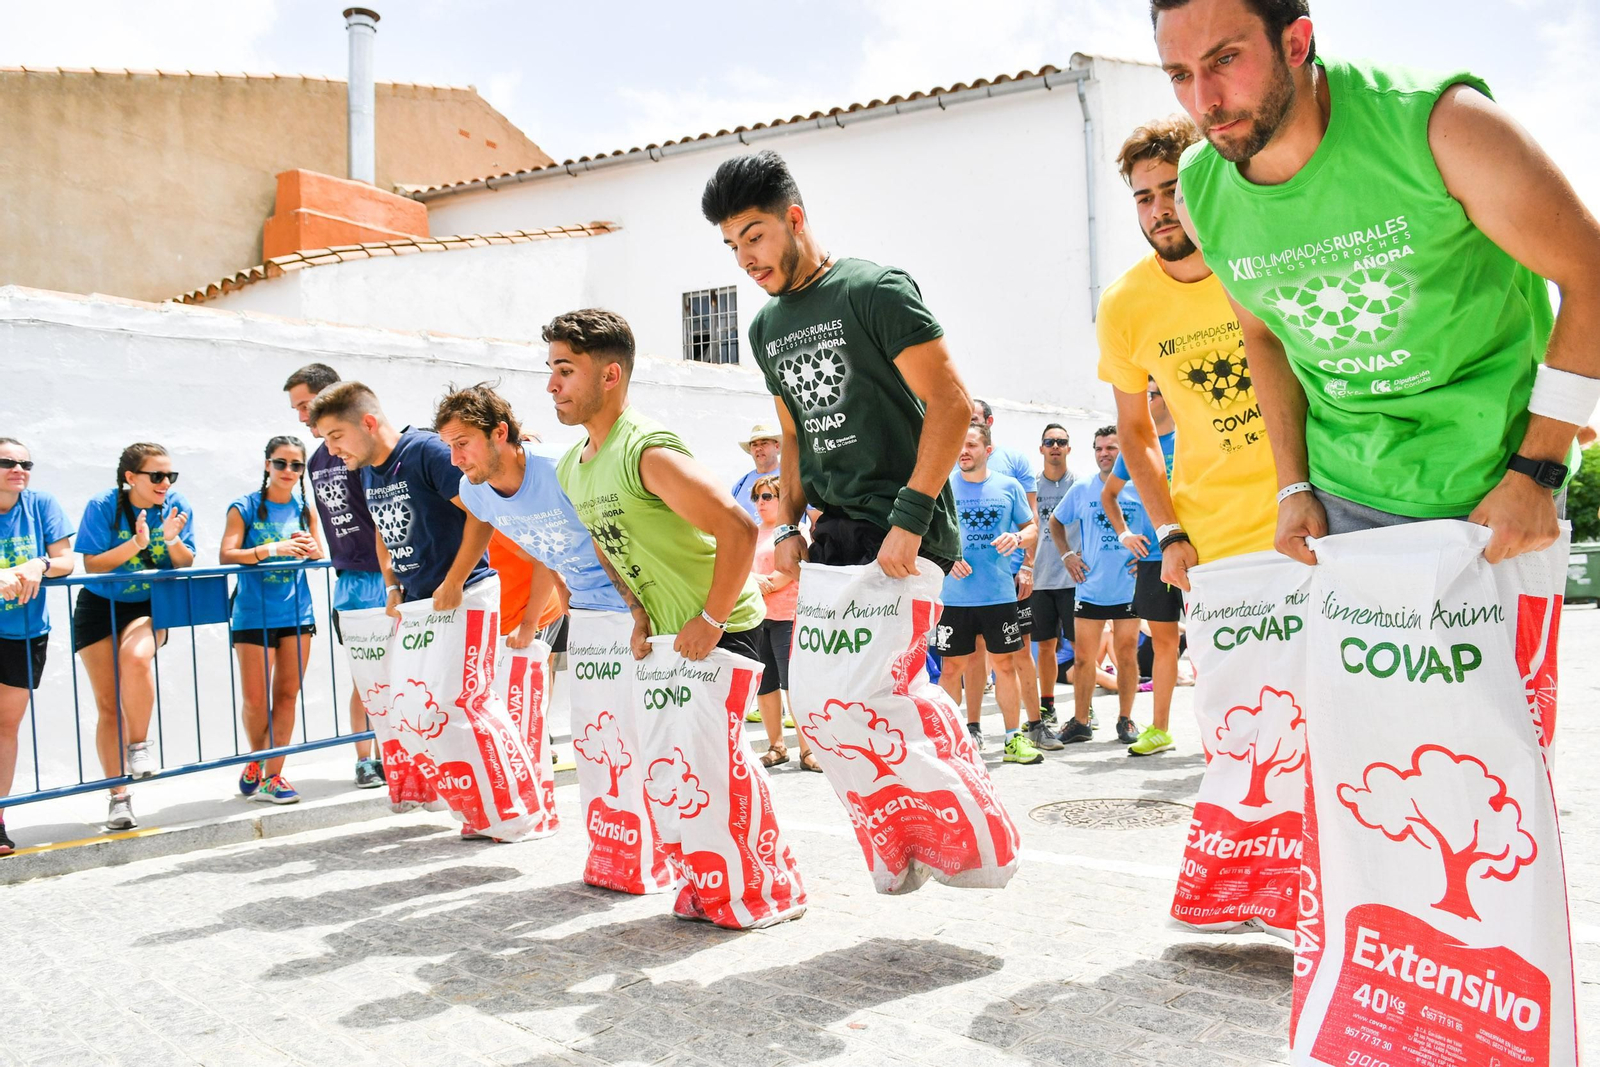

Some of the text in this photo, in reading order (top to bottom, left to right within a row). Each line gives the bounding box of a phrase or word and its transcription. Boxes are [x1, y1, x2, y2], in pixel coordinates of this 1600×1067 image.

[1354, 245, 1415, 272] AÑORA
[817, 338, 846, 350] AÑORA
[1318, 349, 1412, 374] COVAP
[1394, 370, 1430, 386] Diputación
[804, 412, 846, 433] COVAP
[842, 596, 902, 620] Animal
[1190, 600, 1275, 621] Alimentación
[1321, 590, 1422, 630] limentación
[799, 625, 872, 655] COVAP
[1213, 615, 1303, 651] COVAP
[350, 646, 385, 660] COVAP
[1340, 637, 1482, 684] COVAP
[575, 661, 621, 680] COVAP
[678, 660, 721, 682] Animal
[501, 729, 527, 782] COVAP
[733, 793, 748, 830] Animal
[758, 829, 788, 886] COVAP
[924, 847, 936, 859] de
[1196, 861, 1208, 877] Kg
[1223, 903, 1235, 914] de
[1238, 902, 1276, 918] futuro
[1294, 864, 1320, 978] COVAP
[1352, 926, 1541, 1032] Extensivo
[1352, 983, 1389, 1014] 40
[1389, 994, 1406, 1015] Kg
[1352, 1013, 1395, 1033] www.covap.es
[1344, 1026, 1392, 1051] 957 77 37 30
